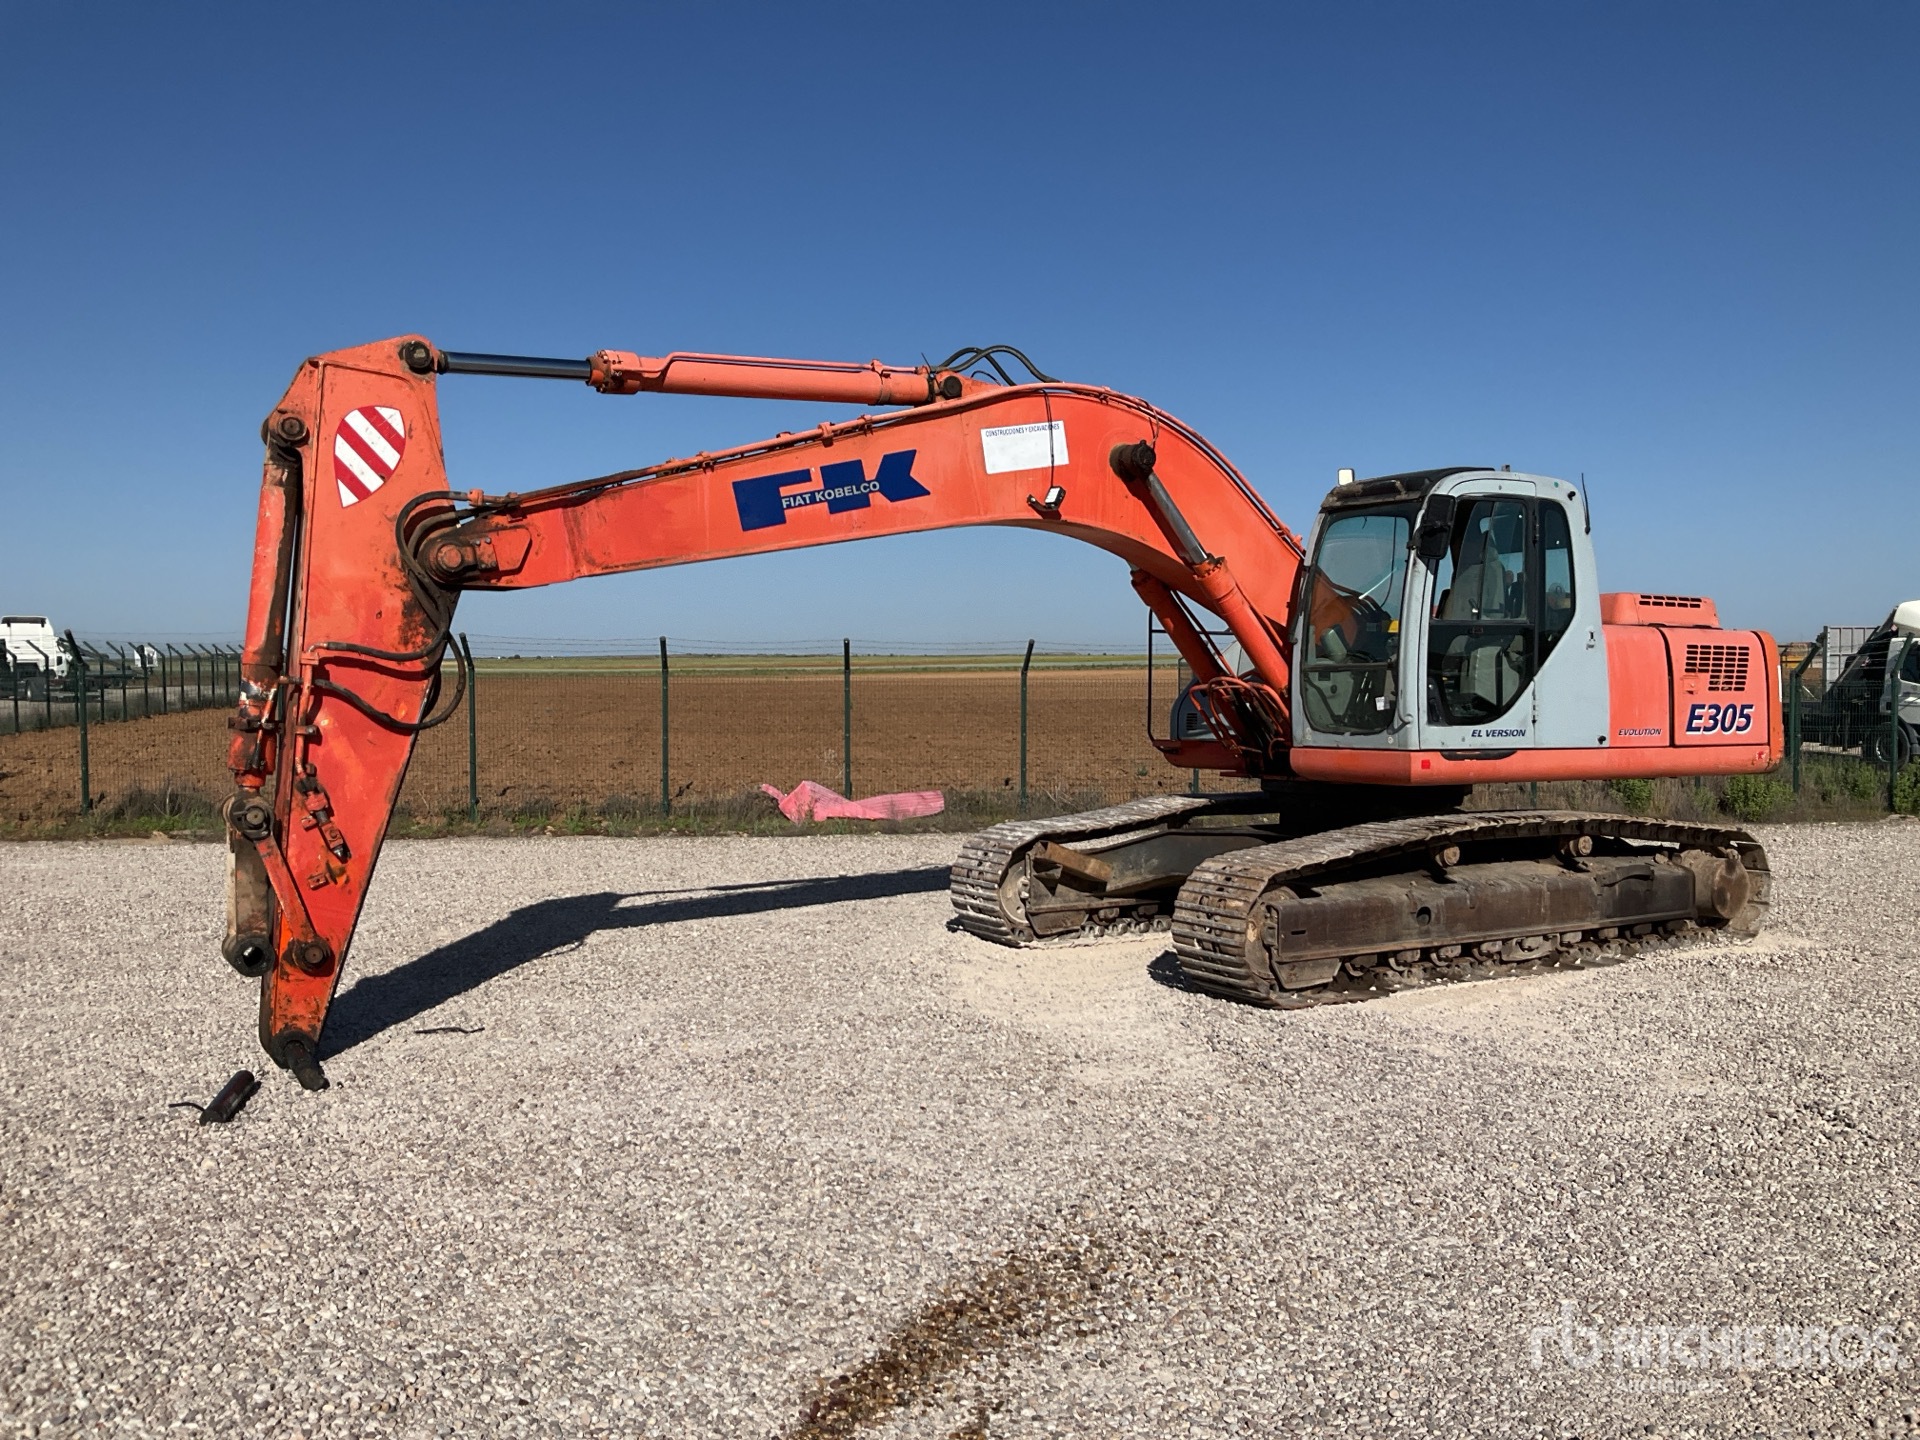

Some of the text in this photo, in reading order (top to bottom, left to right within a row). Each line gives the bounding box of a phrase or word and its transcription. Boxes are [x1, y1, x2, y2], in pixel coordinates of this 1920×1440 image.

[985, 426, 1025, 437] CONSTRUCCIONES
[1029, 423, 1060, 433] EXCAVACINES
[781, 480, 880, 509] FIAT KOBELCO
[1686, 703, 1754, 735] E305
[1471, 729, 1526, 738] EL VERSION
[1618, 728, 1662, 736] EVOLUTION
